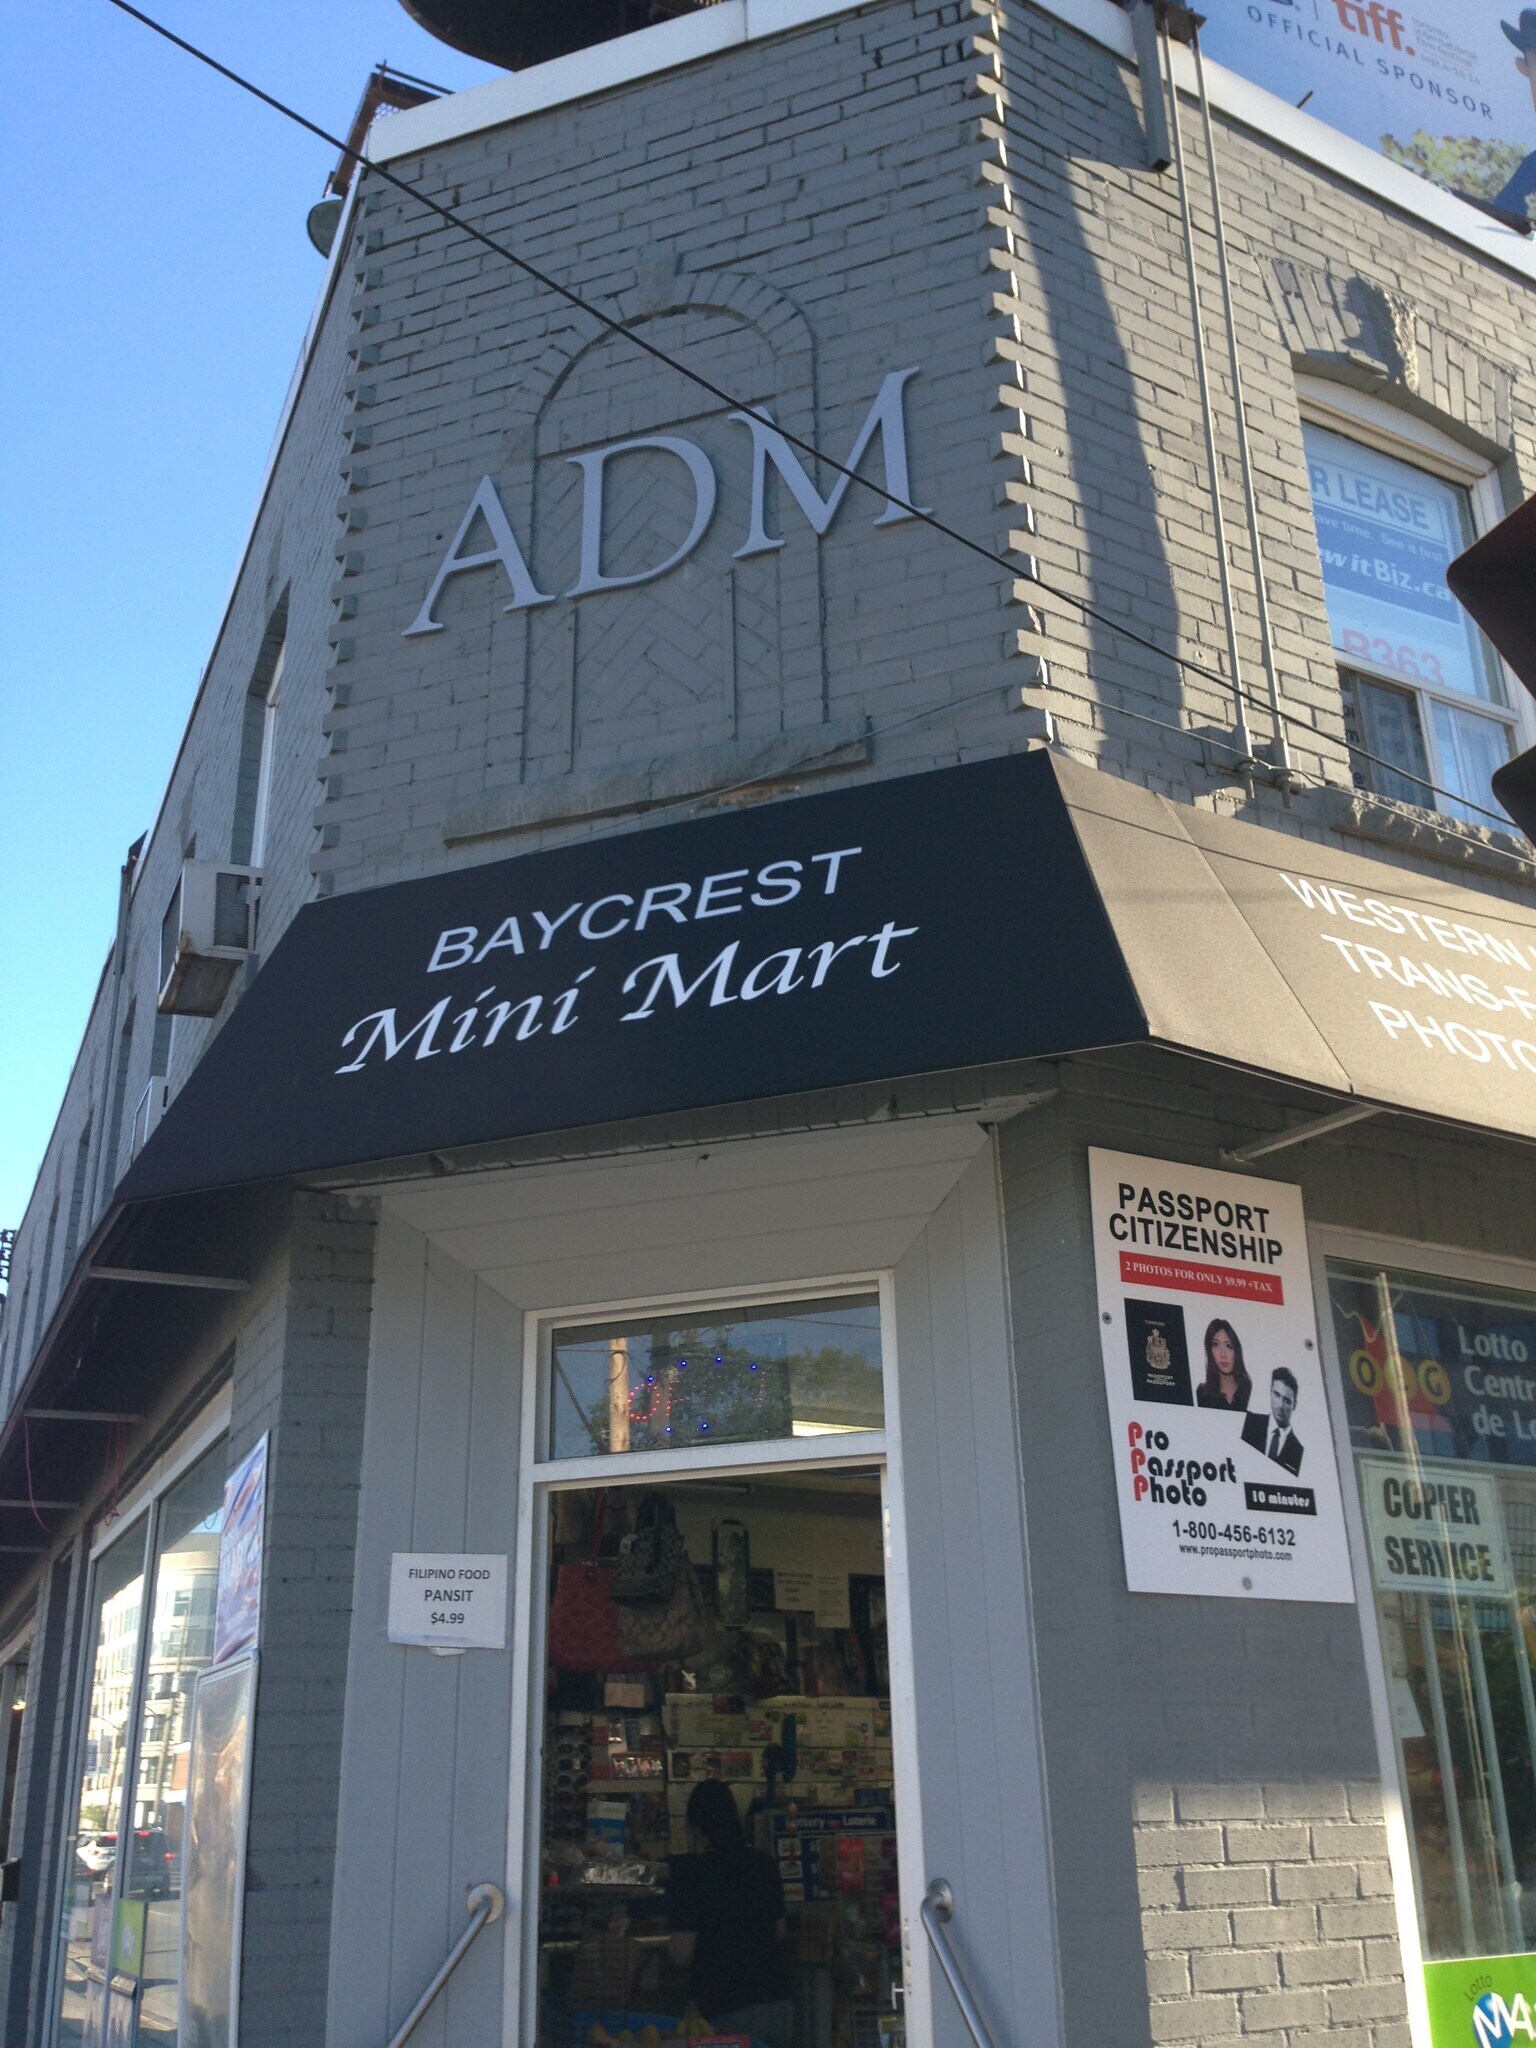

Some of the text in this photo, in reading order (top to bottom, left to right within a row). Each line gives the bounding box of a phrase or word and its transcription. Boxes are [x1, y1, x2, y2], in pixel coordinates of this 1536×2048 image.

[1247, 5, 1493, 121] OFFICIAL SPONSOR
[401, 366, 934, 638] ADM
[1337, 472, 1430, 530] LEASE
[426, 847, 862, 973] BAYCREST
[1279, 873, 1532, 971] WESTERN
[334, 922, 919, 1074] Mini Mart
[1119, 1183, 1269, 1233] PASSPORT
[1109, 1213, 1283, 1264] CITIZENSHIP
[1125, 1261, 1131, 1271] 2
[1133, 1262, 1173, 1277] PHOTOS
[1175, 1268, 1195, 1281] FOR
[1196, 1271, 1223, 1285] ONLY
[1458, 1324, 1528, 1362] Lotto
[1128, 1421, 1169, 1450] Pro
[1472, 1403, 1506, 1437] de
[1131, 1448, 1236, 1485] Passport
[1133, 1474, 1207, 1507] Photo
[1252, 1490, 1310, 1508] 10 minutes
[1383, 1477, 1481, 1525] COPIER
[1173, 1519, 1296, 1547] 1-800-456-6132
[1179, 1544, 1293, 1561] www.propassportphoto.com
[1384, 1535, 1496, 1582] SERVICE
[408, 1568, 491, 1580] FILIPINO FOOD
[424, 1589, 474, 1602] PANSIT
[430, 1610, 465, 1625] $4.99
[1472, 1992, 1536, 2048] MA
